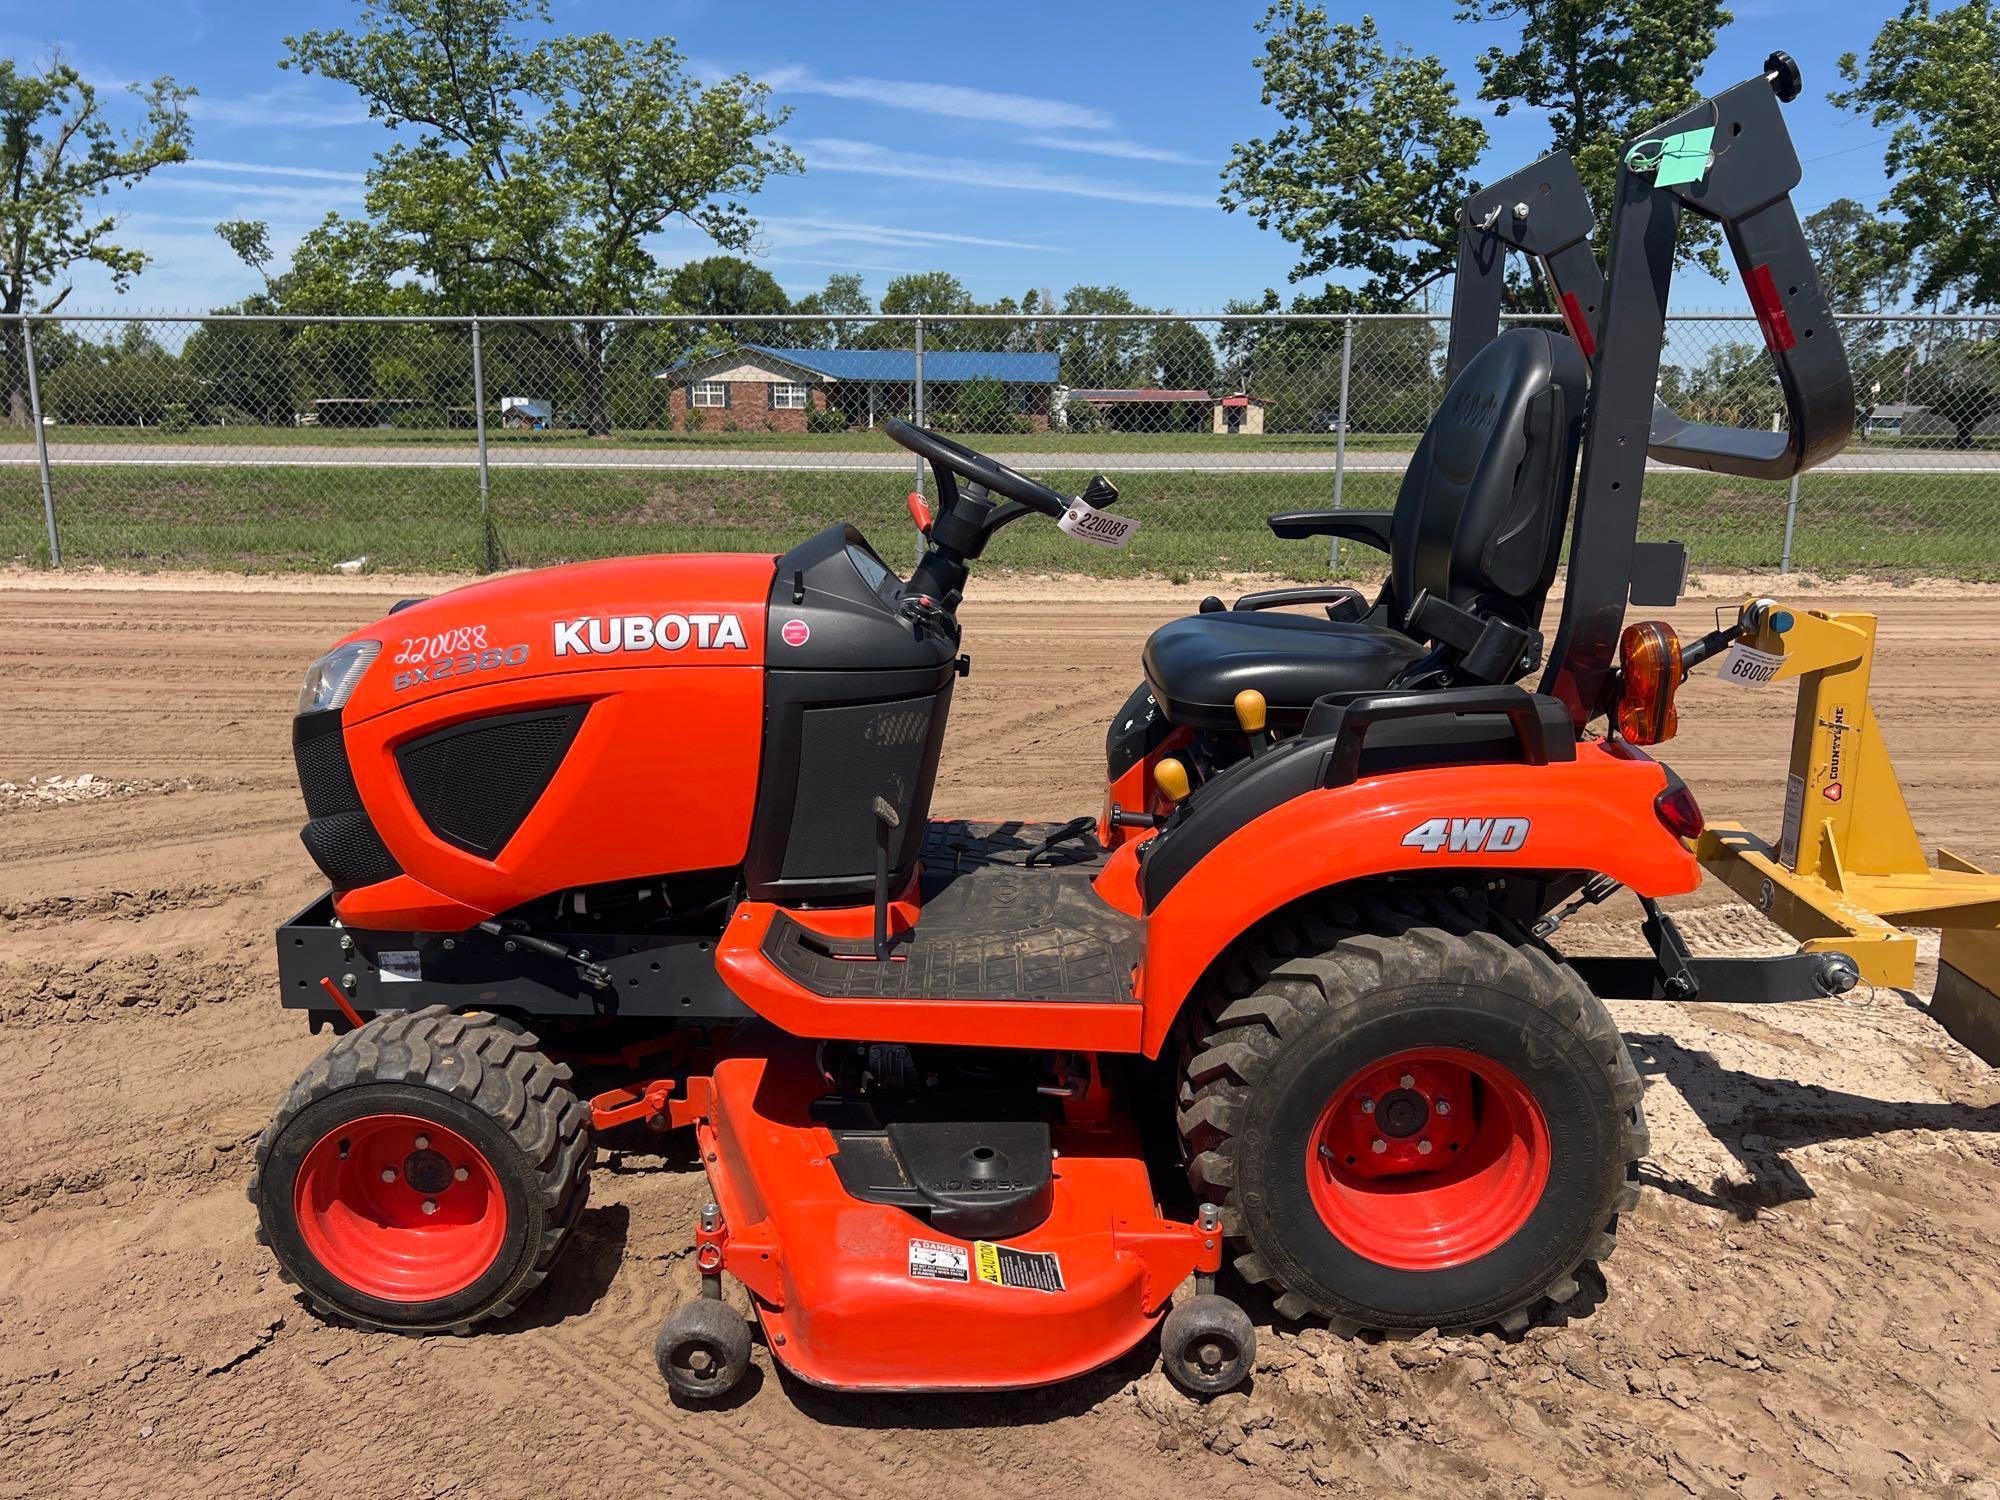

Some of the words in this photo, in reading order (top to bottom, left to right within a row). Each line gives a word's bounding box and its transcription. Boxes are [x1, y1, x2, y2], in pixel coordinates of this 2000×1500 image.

[1078, 512, 1129, 537] 220088
[394, 625, 489, 664] 220088
[553, 613, 749, 657] KUBOTA
[393, 644, 529, 691] BX2380
[1829, 708, 1844, 780] COUNTYLNE
[1400, 817, 1531, 853] 4WD
[932, 1179, 964, 1190] NO
[969, 1178, 1025, 1190] STEP
[922, 1242, 966, 1255] DANGER
[980, 1243, 997, 1276] CAUTION
